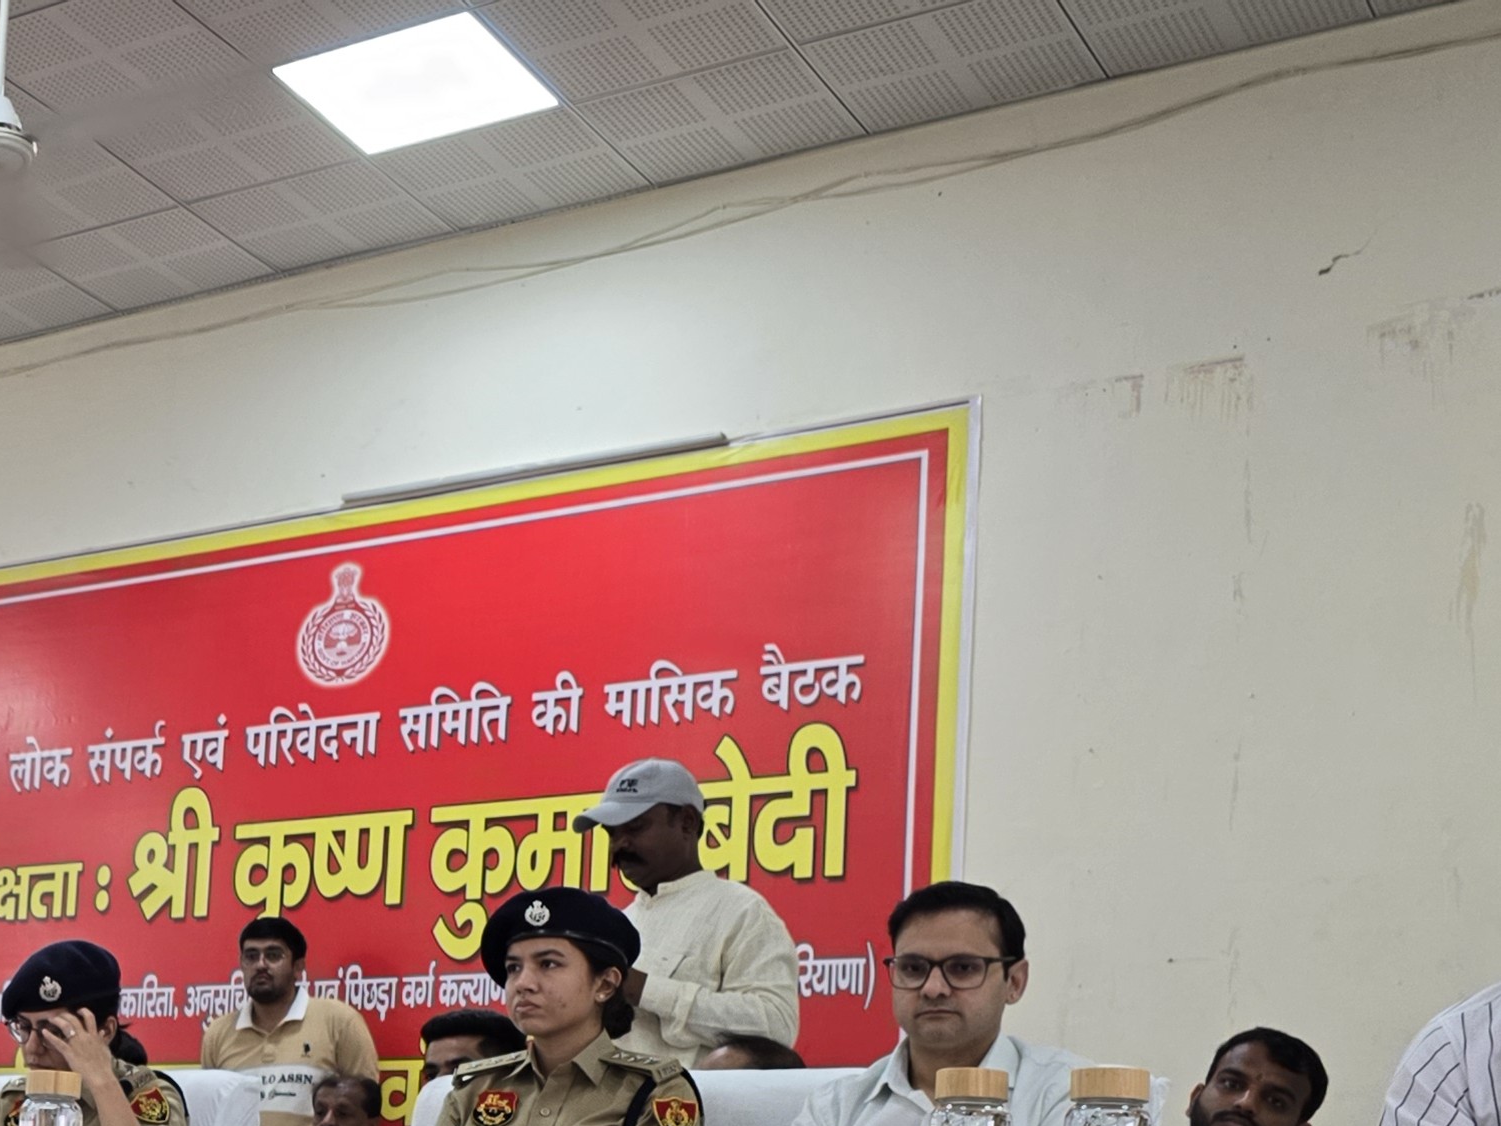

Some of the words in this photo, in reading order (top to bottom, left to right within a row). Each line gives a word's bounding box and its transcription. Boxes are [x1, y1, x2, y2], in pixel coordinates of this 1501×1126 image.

[9, 735, 74, 793] लोक
[87, 719, 166, 785] संपर्क
[181, 712, 230, 780] एवं
[245, 701, 382, 768] परिवेदना
[398, 680, 513, 753] समिति
[531, 669, 584, 736] की
[603, 658, 739, 729] मासिक
[126, 786, 220, 921] श्री
[233, 807, 414, 920] कष्ण
[429, 786, 639, 962] कुमा
[401, 960, 437, 1009] वर्ग
